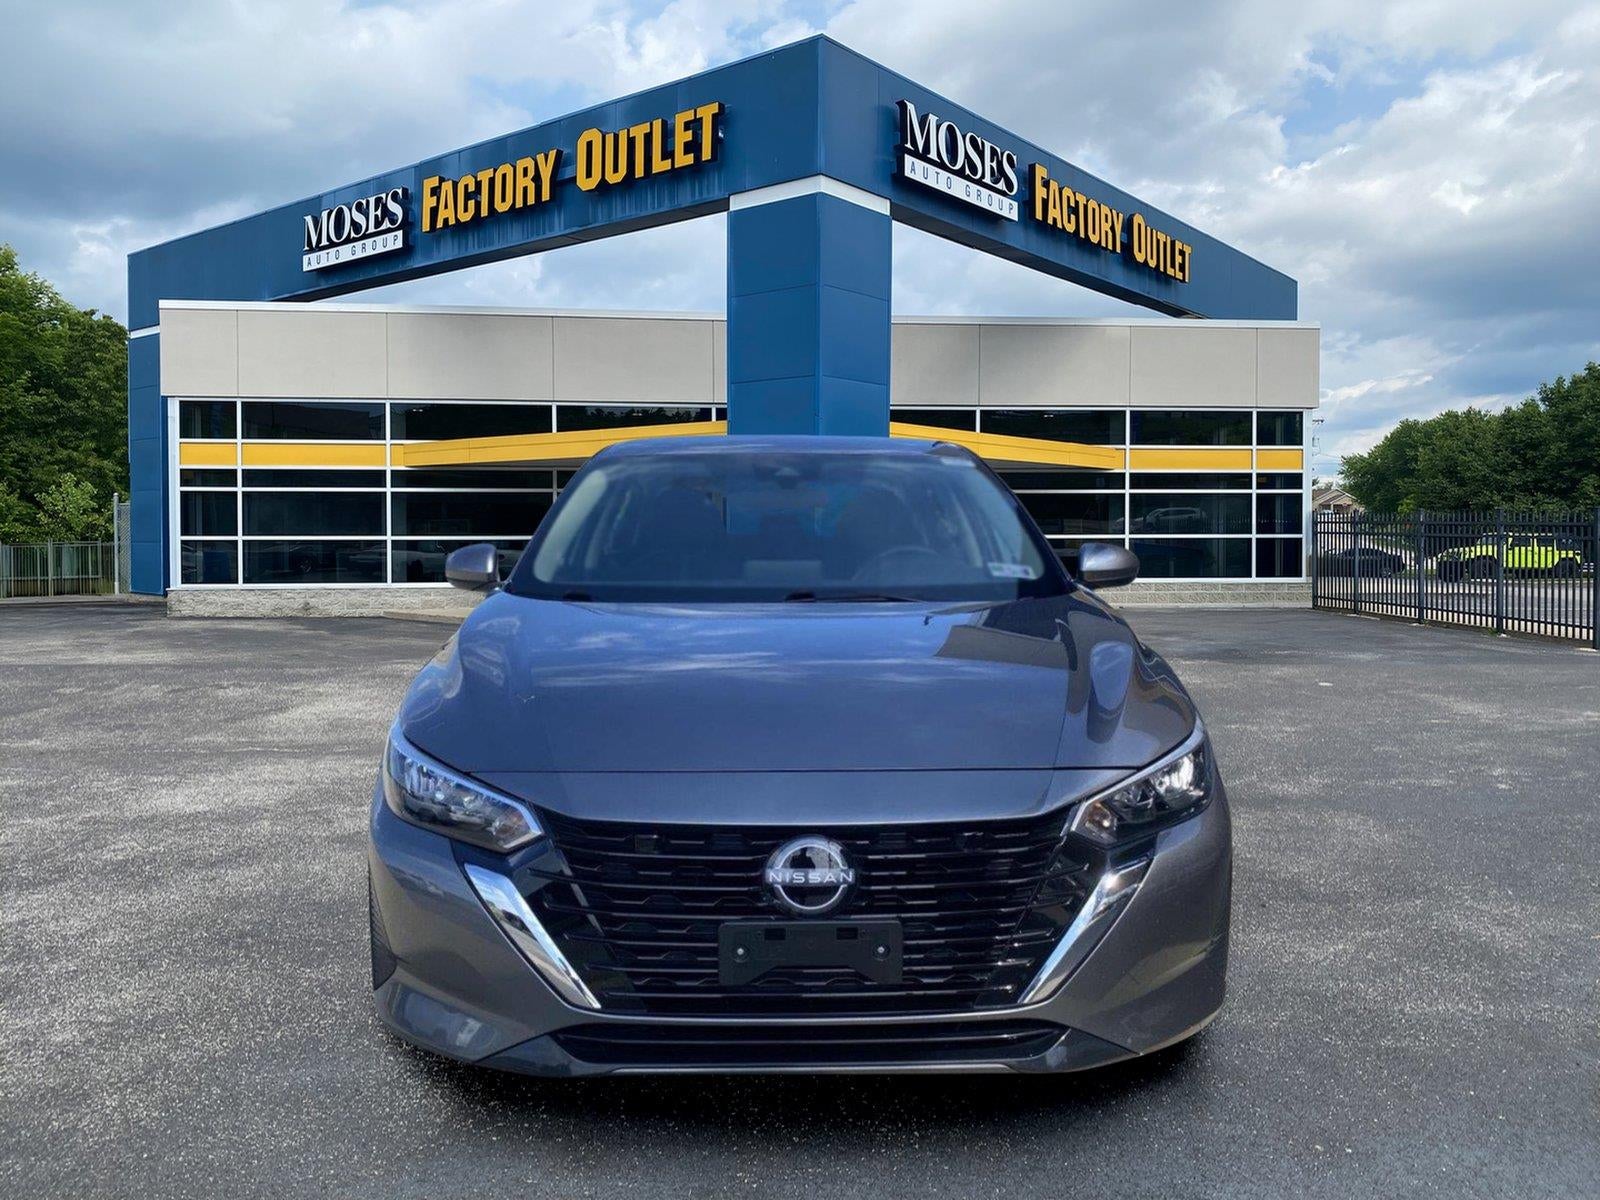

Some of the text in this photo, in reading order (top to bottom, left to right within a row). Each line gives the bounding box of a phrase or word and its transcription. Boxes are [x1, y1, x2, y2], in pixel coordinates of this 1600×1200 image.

[421, 101, 719, 232] FACTORY OUTLET
[903, 99, 1019, 196] MOSES
[303, 187, 403, 252] MOSES
[909, 160, 1014, 214] AUTO GROUP
[306, 234, 400, 268] AUTO GROUP
[1034, 163, 1192, 283] FACTORY OUTLET
[769, 871, 852, 883] NISSAN
